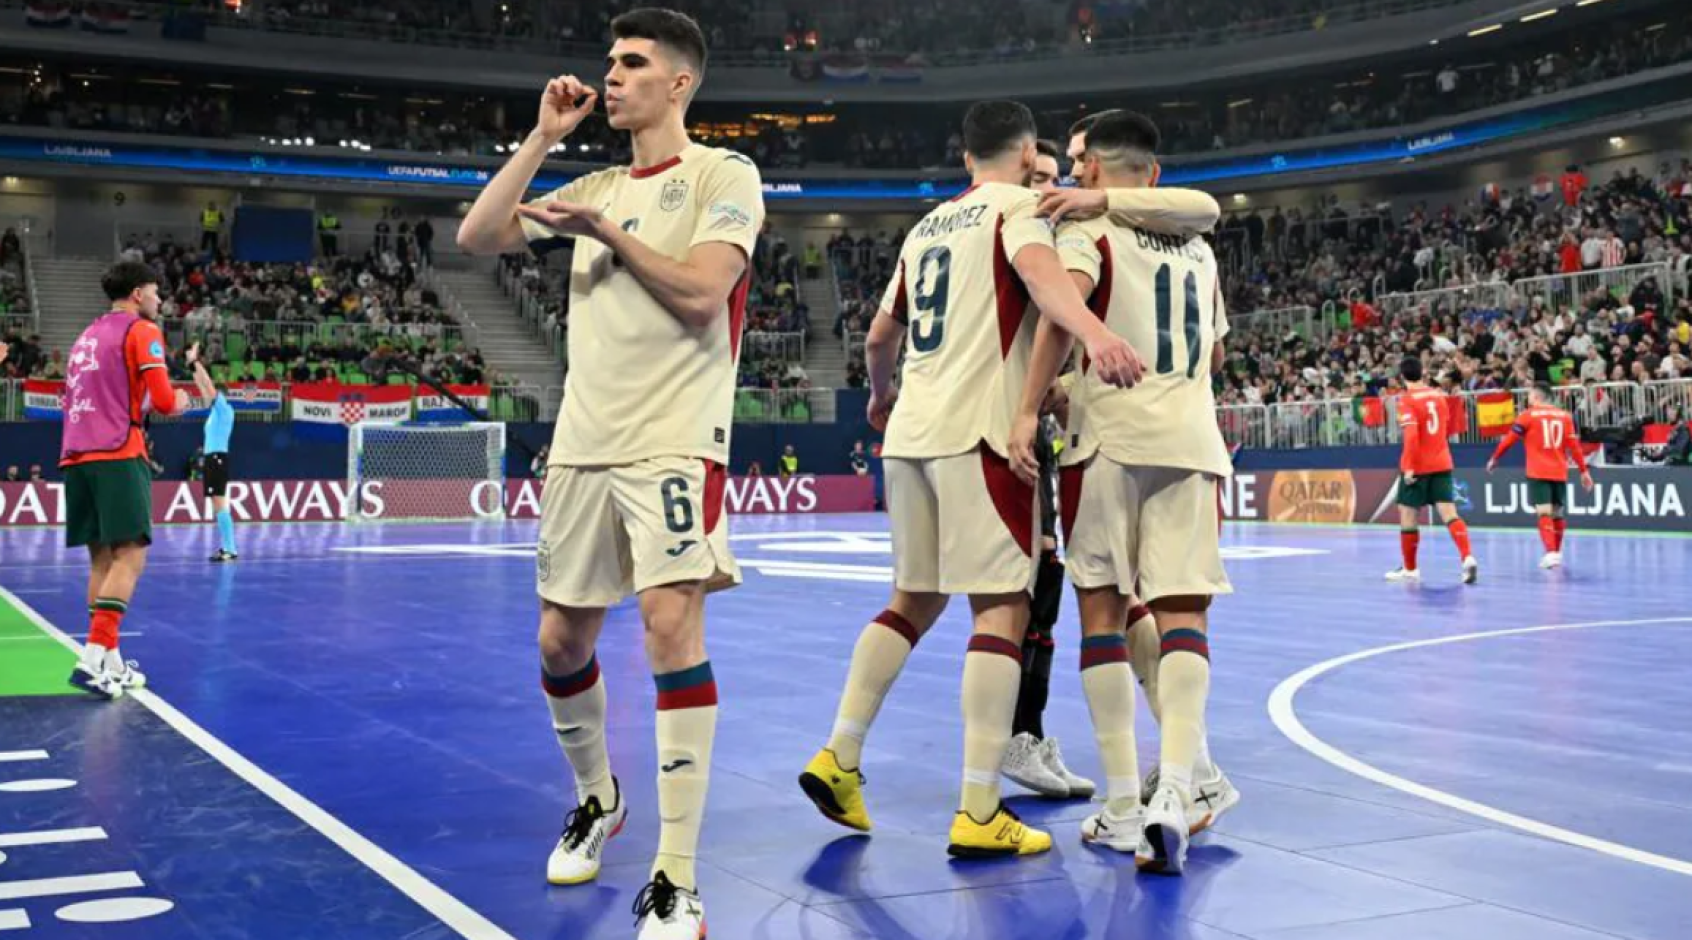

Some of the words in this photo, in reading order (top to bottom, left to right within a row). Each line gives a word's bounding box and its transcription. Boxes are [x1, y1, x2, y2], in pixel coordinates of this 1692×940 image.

[761, 183, 802, 192] BLJANA
[911, 245, 953, 353] 9
[1154, 262, 1201, 380] 11
[304, 405, 331, 417] NOVI
[369, 408, 407, 419] MAROF
[1426, 401, 1440, 435] 3
[1542, 417, 1565, 450] 10
[164, 480, 385, 521] AIRWAYS
[659, 476, 694, 533] 6
[724, 477, 817, 512] WAYS
[1280, 480, 1342, 503] QATAR
[1485, 482, 1686, 517] LJULJANA
